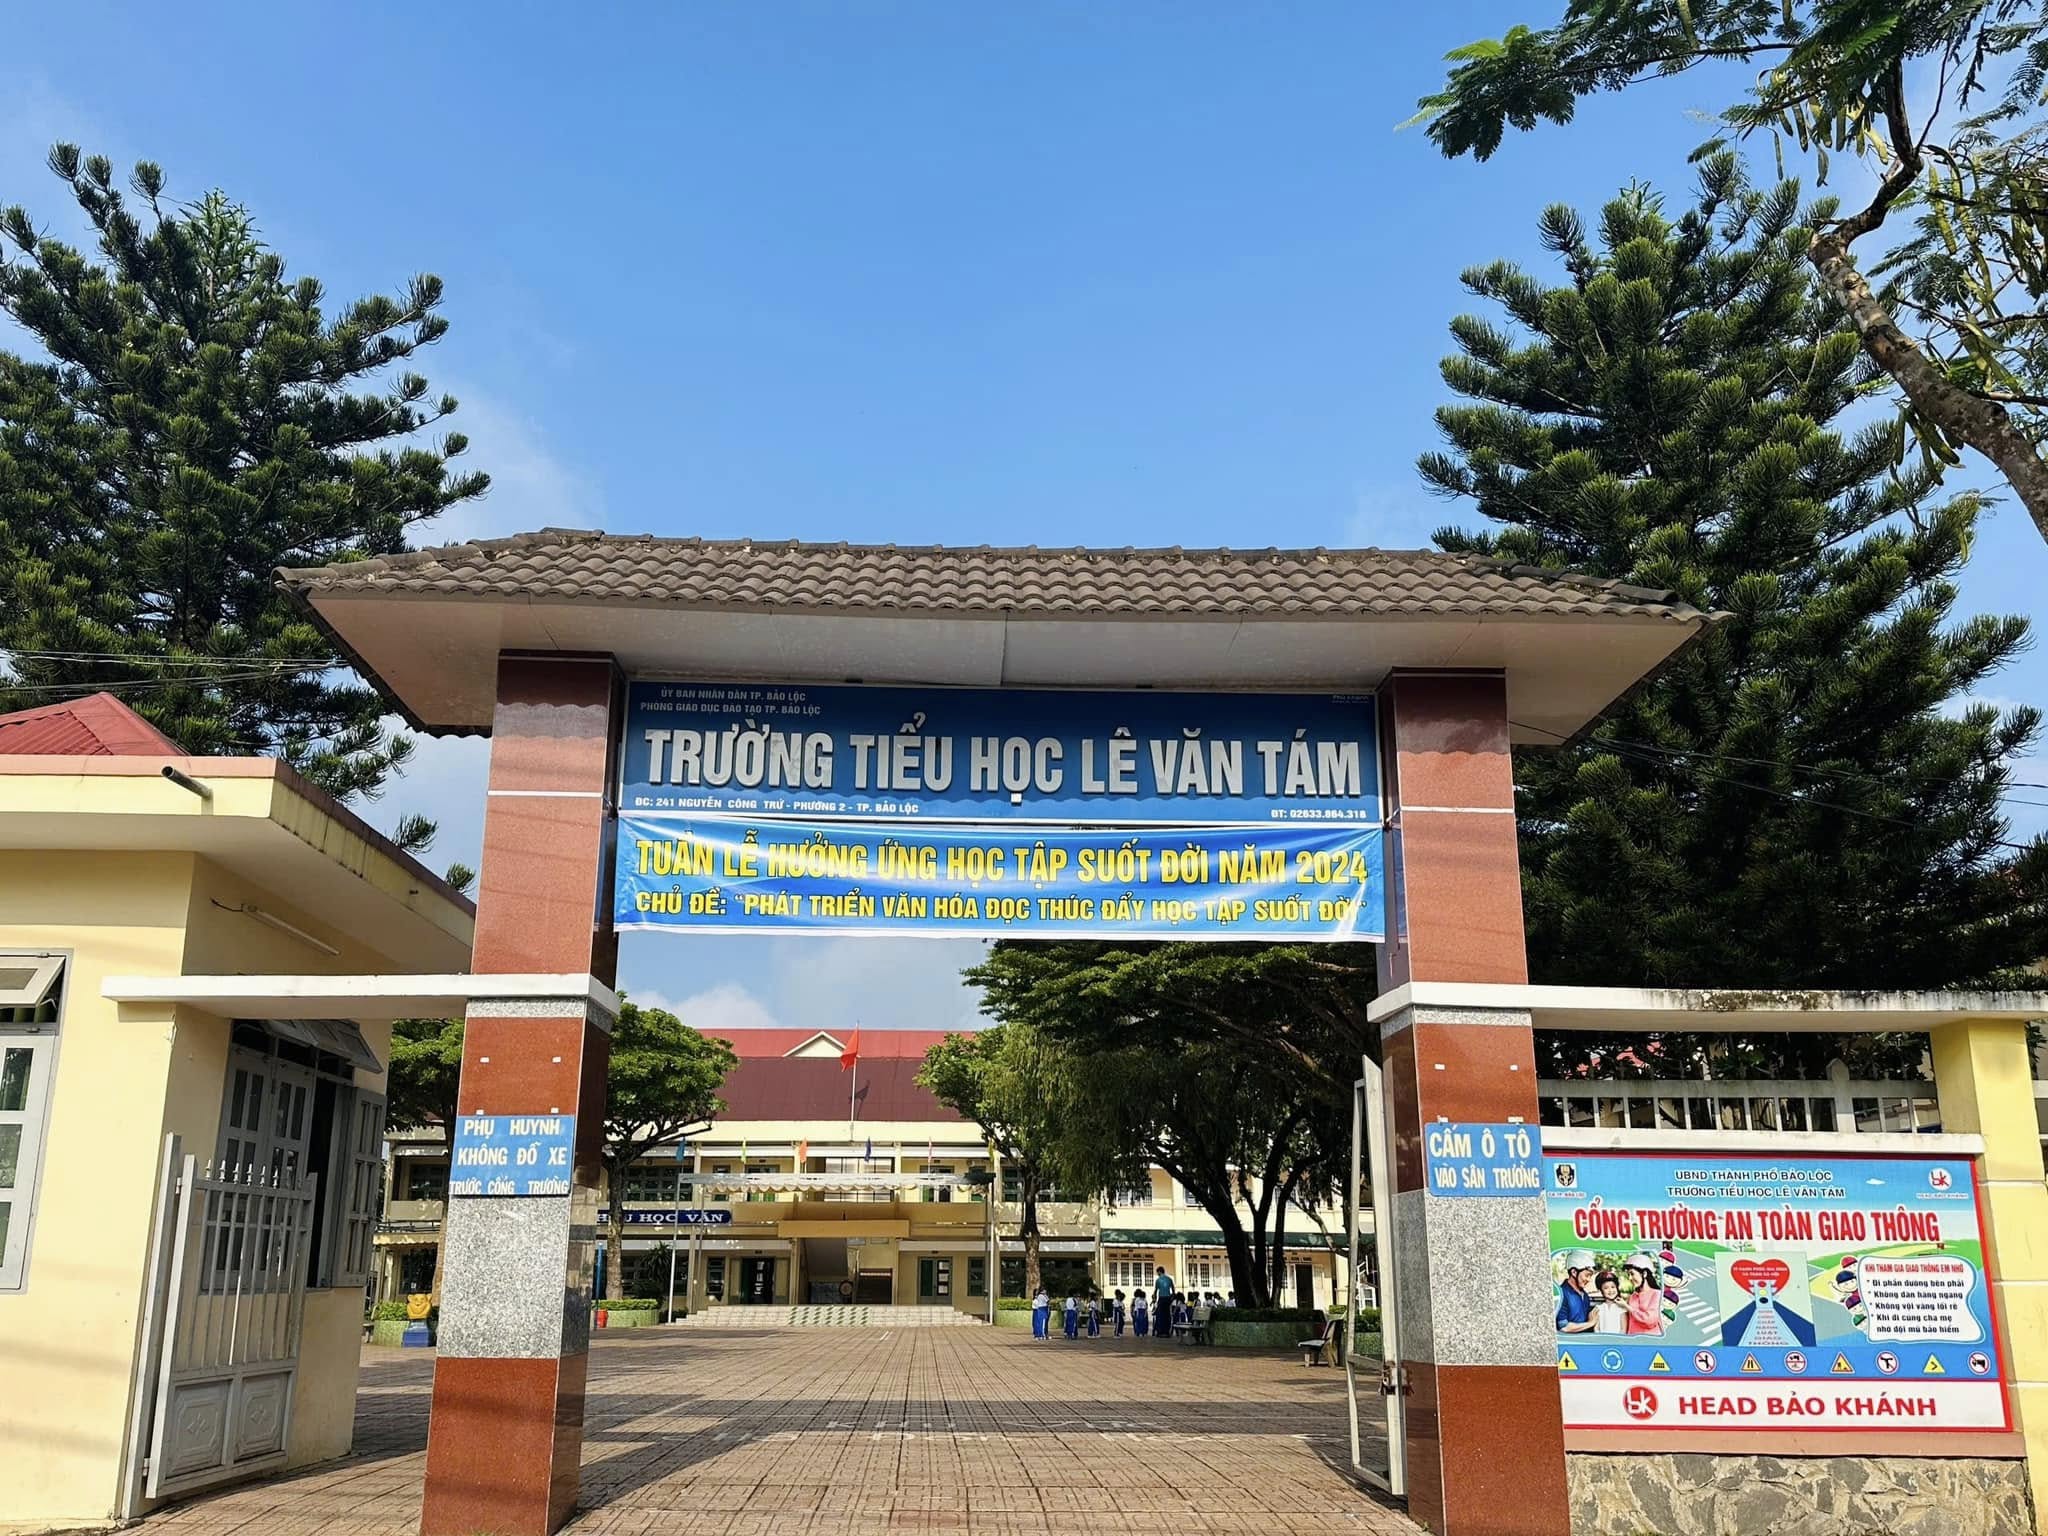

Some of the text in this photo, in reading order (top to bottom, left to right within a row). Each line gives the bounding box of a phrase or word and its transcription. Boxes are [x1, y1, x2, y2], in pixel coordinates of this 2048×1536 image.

[676, 689, 696, 698] BAN
[750, 692, 764, 700] TP.
[788, 691, 806, 704] LỘC
[744, 704, 762, 716] TẠO
[764, 705, 778, 714] TP.
[802, 704, 821, 717] LỘC
[645, 711, 1362, 806] TRƯỜNG TIỂU HỌC LÊ VĂN TÁM
[656, 798, 674, 807] 241
[728, 798, 757, 808] CÔNG
[838, 803, 846, 811] 2
[856, 803, 873, 812] TP.
[875, 800, 896, 813] BẢO
[899, 802, 919, 815] LỘC
[636, 829, 1368, 889] TUẦN LỄ HƯỞNG ỨNG HỌC TẬP SUỐT ĐỜI NĂM 2024
[636, 884, 683, 914] CHỦ
[689, 886, 728, 916] ĐỀ:
[808, 888, 876, 917] TRIỂN
[882, 892, 928, 918] VĂN
[934, 892, 980, 918] HÓA
[984, 896, 1030, 924] ĐỌC
[1038, 894, 1096, 920] THÚC
[1101, 892, 1145, 921] ĐẨY
[1152, 900, 1197, 925] HỌC
[1204, 897, 1247, 926] TẬP
[1254, 894, 1314, 922] SUỐT
[464, 1118, 560, 1139] PHỤ HUYNH
[1430, 1124, 1531, 1158] CẤM Ô TÔ
[457, 1141, 568, 1166] KHÔNG ĐỖ XE
[449, 1176, 569, 1194] TRƯỚC CỔNG TRƯỜNG
[1434, 1161, 1540, 1189] VÀO SÂN TRƯỜNG
[1676, 1168, 1832, 1184] UBND THÀNH PHỐ BẢO LỘC
[1668, 1183, 1845, 1200] TRƯỜNG TIỂU HỌC LÊ VĂN TÁM
[639, 1213, 678, 1226] HỌC
[1574, 1196, 1941, 1242] CỔNG TRƯỜNG AN TOÀN GIAO THÔNG
[1679, 1391, 1937, 1416] HEAD BẢO KHÁNH
